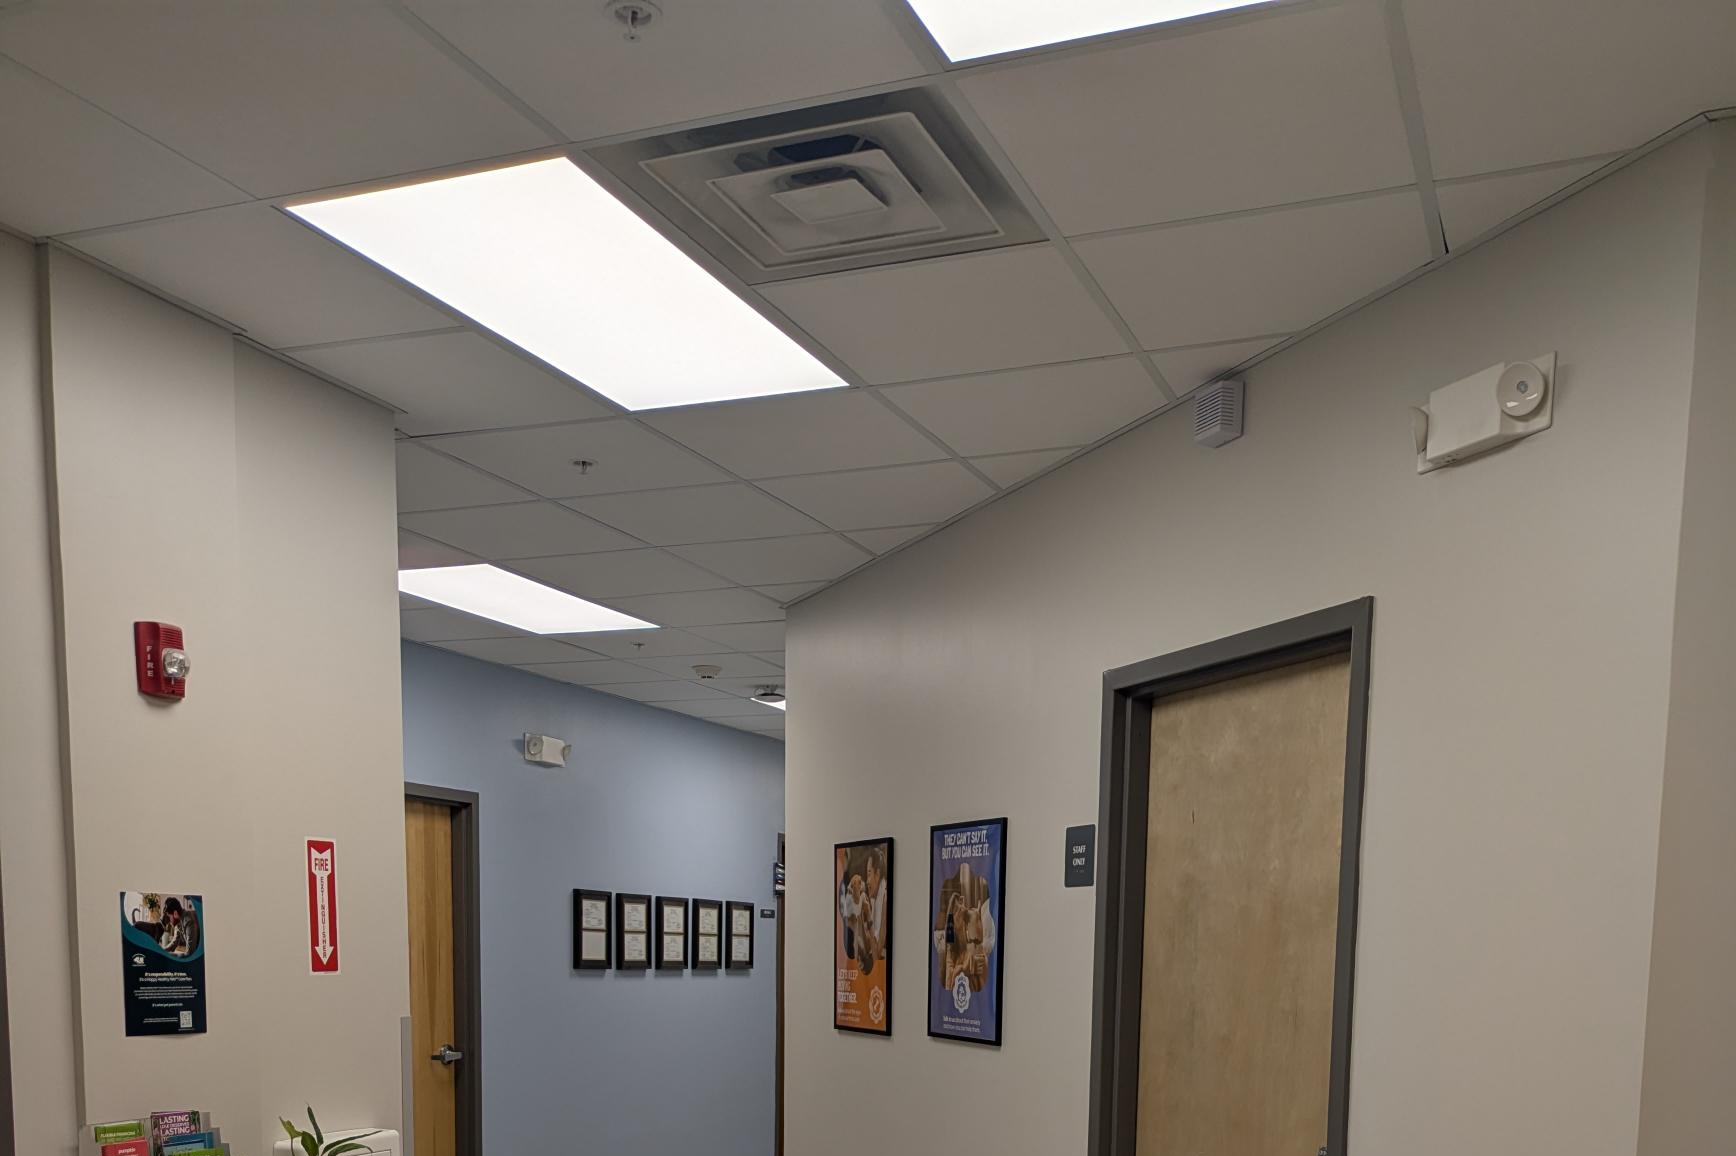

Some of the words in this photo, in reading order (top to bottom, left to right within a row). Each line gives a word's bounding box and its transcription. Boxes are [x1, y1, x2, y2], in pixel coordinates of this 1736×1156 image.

[145, 645, 154, 678] FIRE
[944, 833, 956, 846] THEY
[971, 830, 981, 844] SAY
[941, 847, 951, 860] BUT
[951, 846, 961, 859] YOU
[961, 845, 971, 858] CAN
[972, 844, 982, 857] SEE
[1072, 845, 1086, 854] STAFF
[314, 857, 329, 872] FIRE
[1072, 857, 1085, 866] ONLY
[159, 1114, 189, 1125] LASTING
[160, 1126, 190, 1137] LASTING
